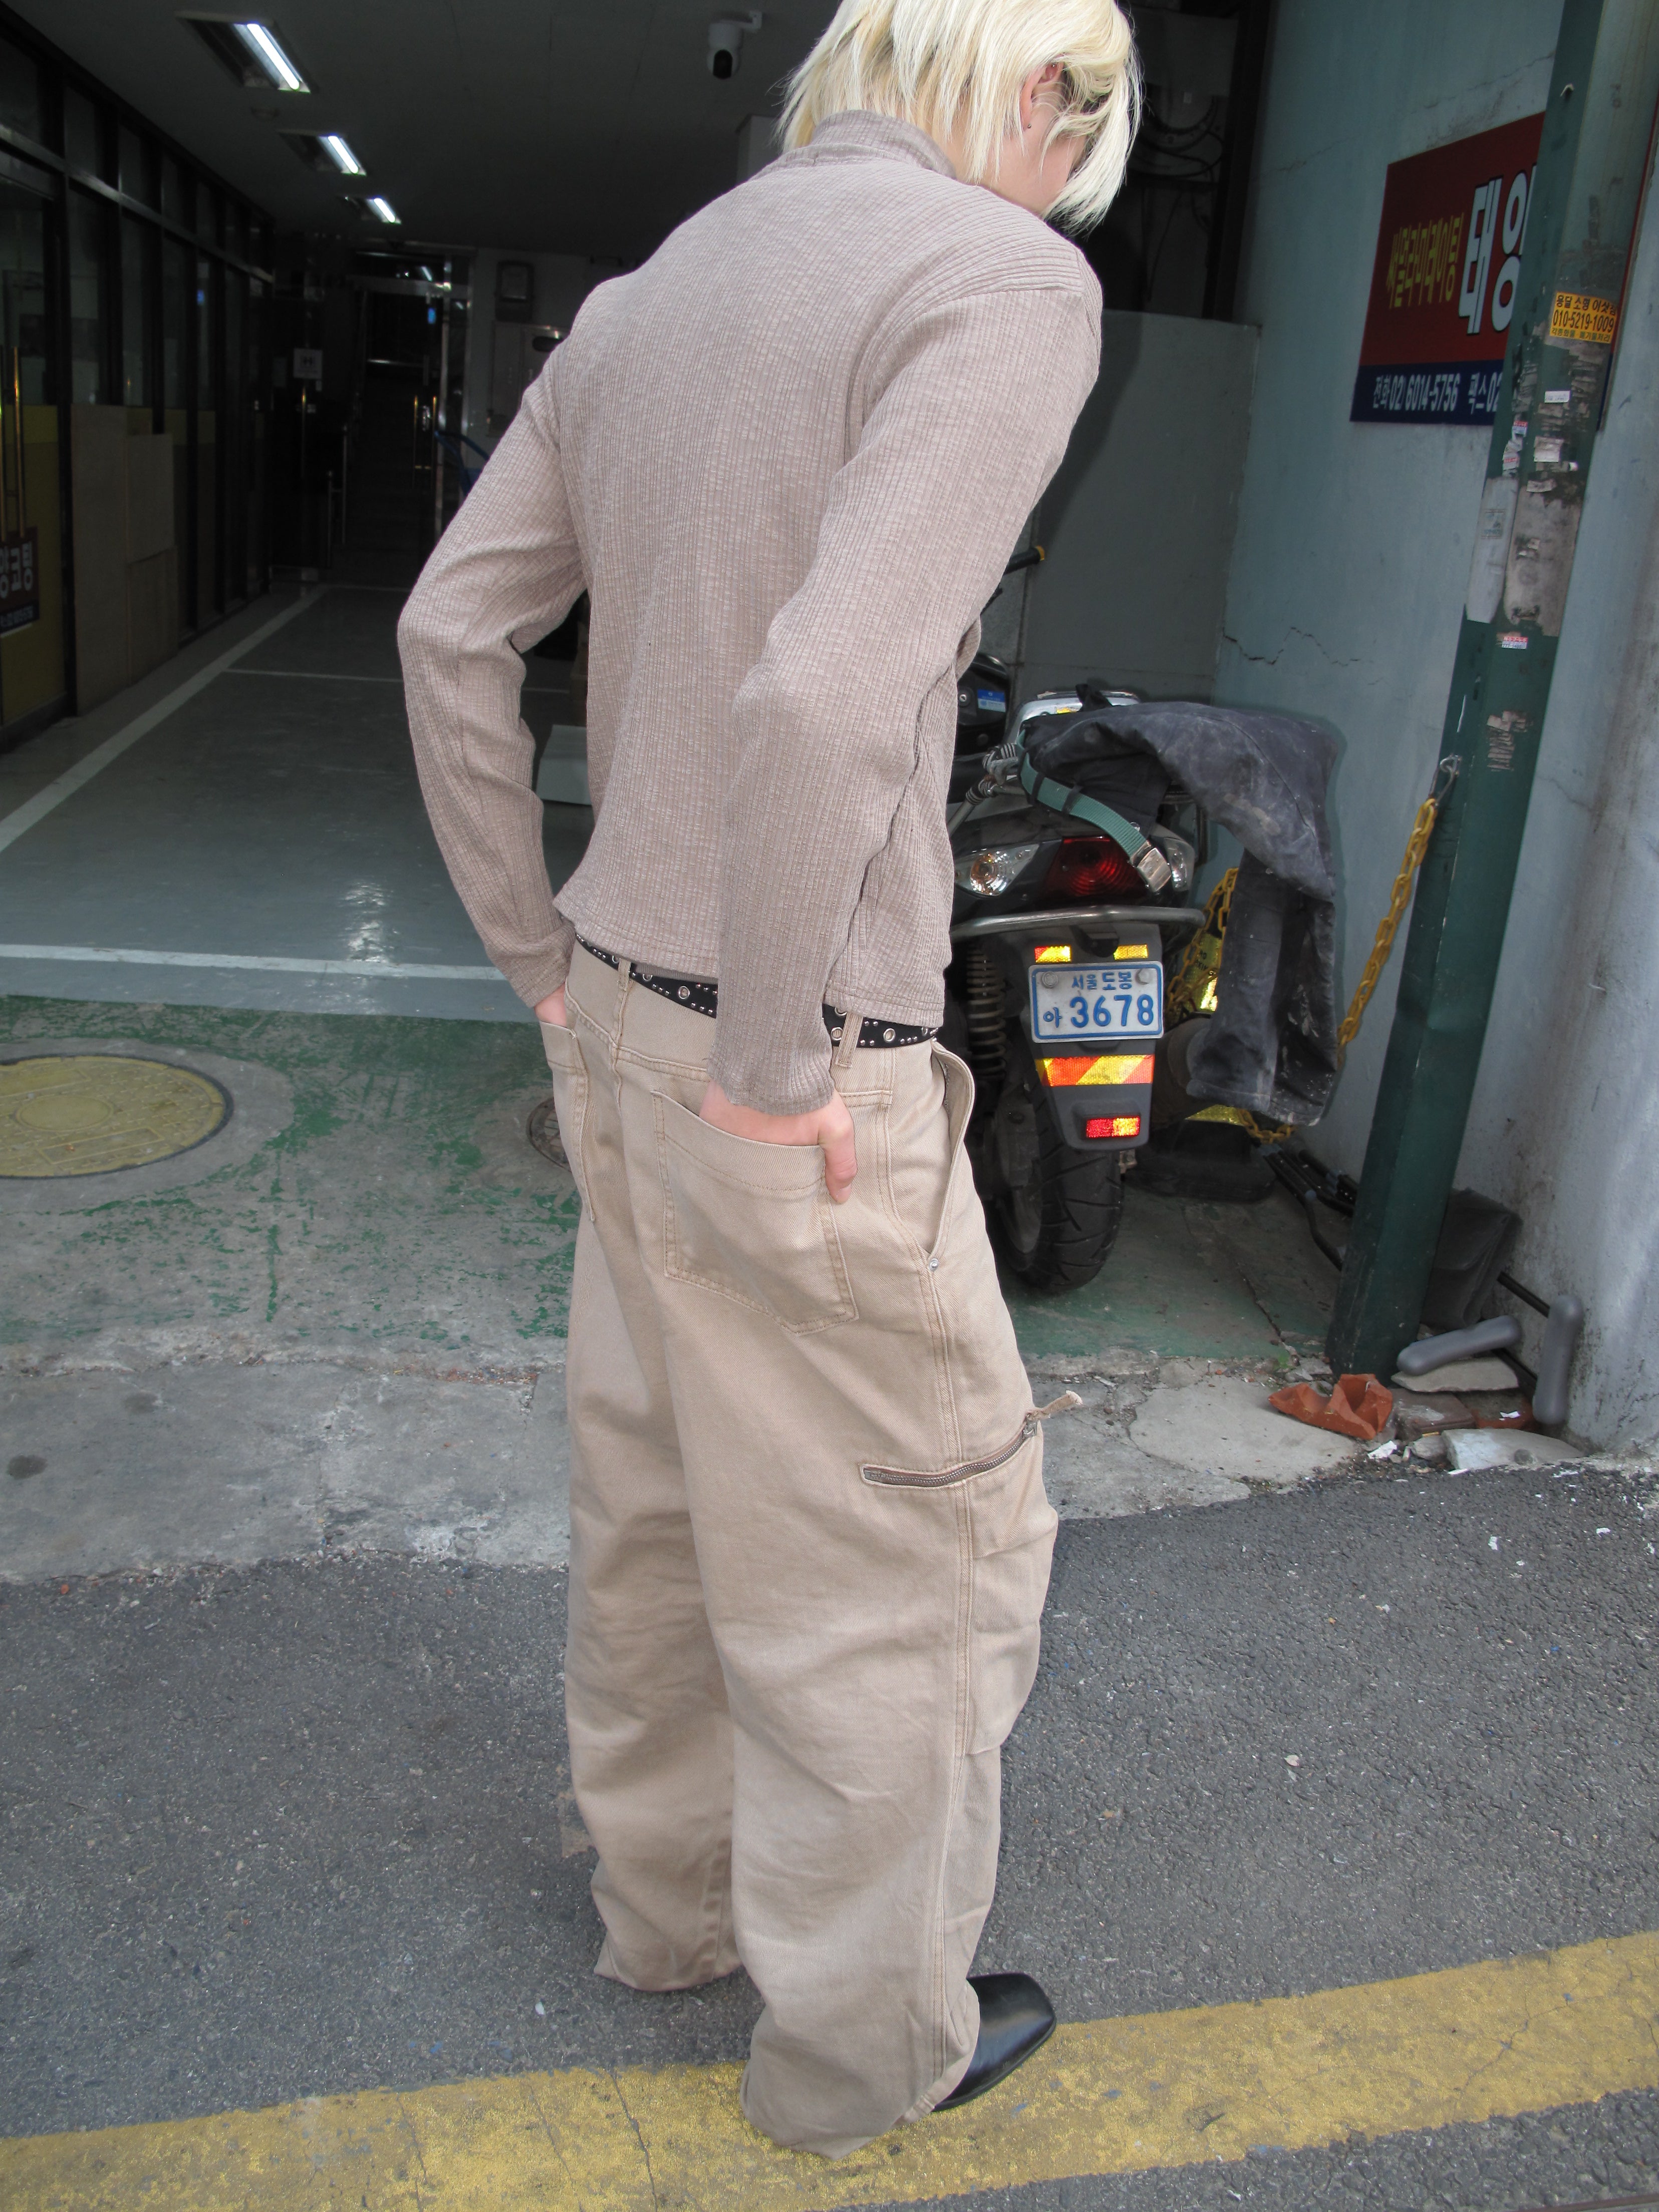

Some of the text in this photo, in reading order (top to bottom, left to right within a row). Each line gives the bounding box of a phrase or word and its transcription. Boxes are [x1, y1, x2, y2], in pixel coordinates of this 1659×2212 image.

[1556, 295, 1572, 308] 용달
[1573, 297, 1590, 311] 소형
[1553, 309, 1614, 333] 010-5219-1009
[1071, 971, 1133, 990] 서울 도봉
[1043, 994, 1154, 1028] 아 3678
